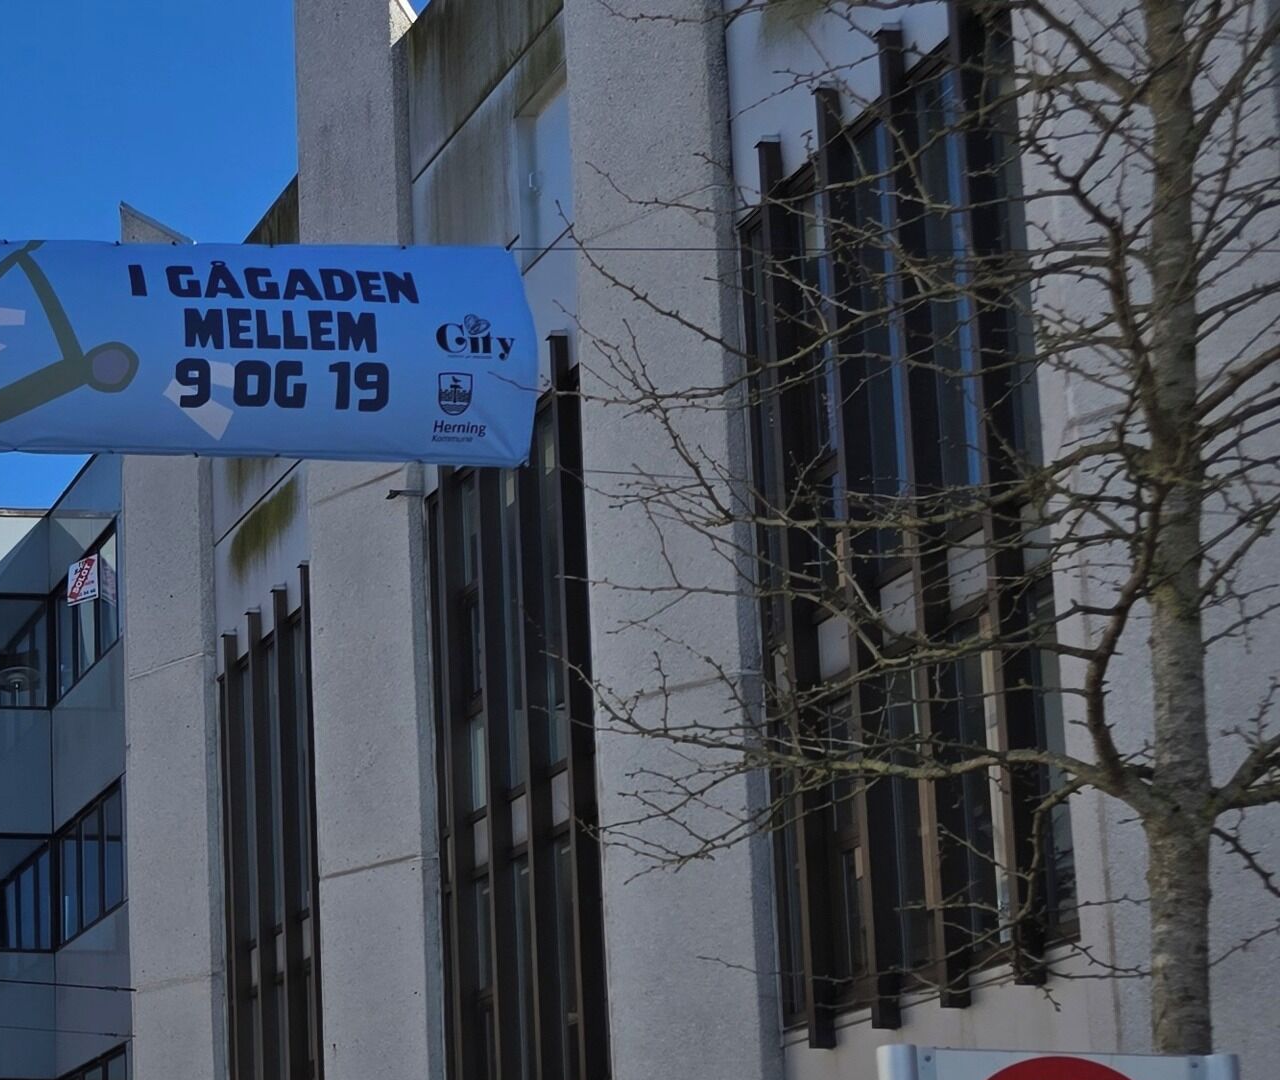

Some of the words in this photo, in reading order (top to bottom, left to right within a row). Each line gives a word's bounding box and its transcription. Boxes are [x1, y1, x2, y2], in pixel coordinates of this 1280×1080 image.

[128, 264, 147, 297] I
[166, 260, 419, 303] GÅGADEN
[184, 308, 377, 353] MELLEM
[436, 322, 516, 361] City
[175, 358, 211, 408] 9
[233, 360, 307, 409] OG
[329, 361, 389, 412] 19
[433, 420, 486, 437] Herning
